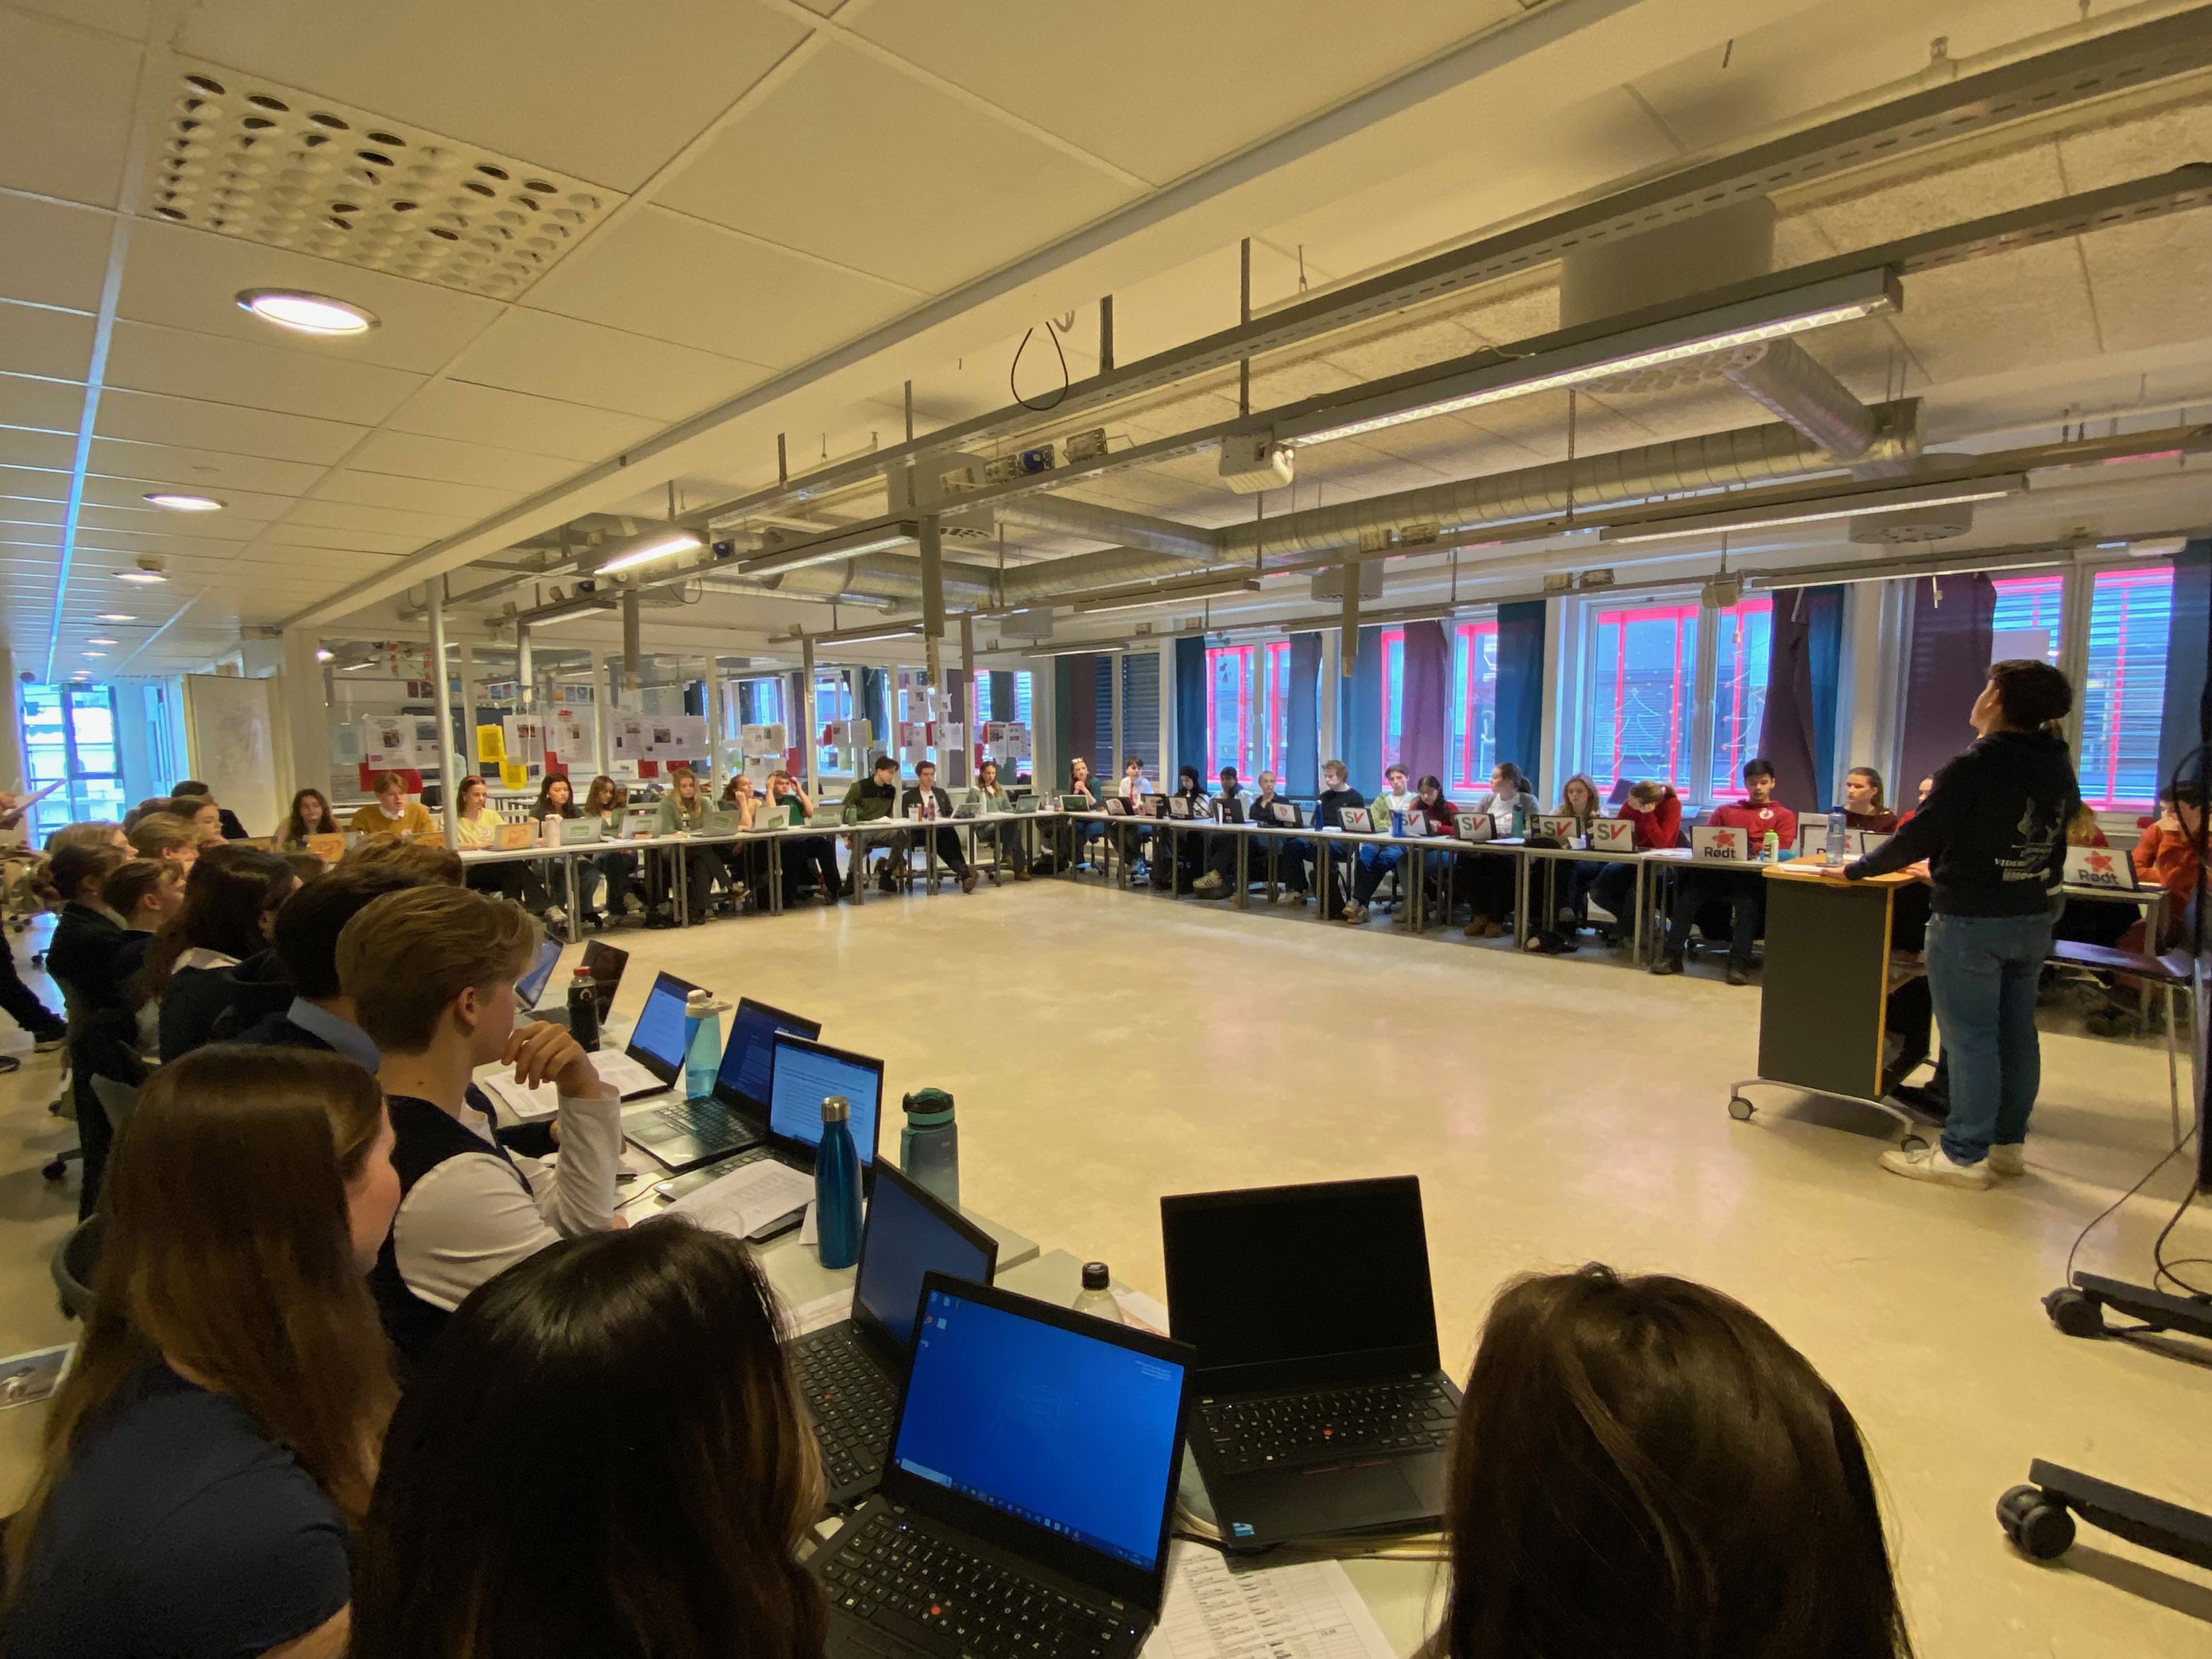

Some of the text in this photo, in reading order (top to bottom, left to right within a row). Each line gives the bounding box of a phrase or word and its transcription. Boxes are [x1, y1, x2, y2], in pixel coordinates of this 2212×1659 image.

[1344, 811, 1364, 824] SV
[1462, 817, 1486, 831] SV
[1544, 821, 1572, 837] SV
[1598, 823, 1628, 841] SV
[1704, 847, 1736, 859] Rødt
[2078, 869, 2120, 885] Rødt
